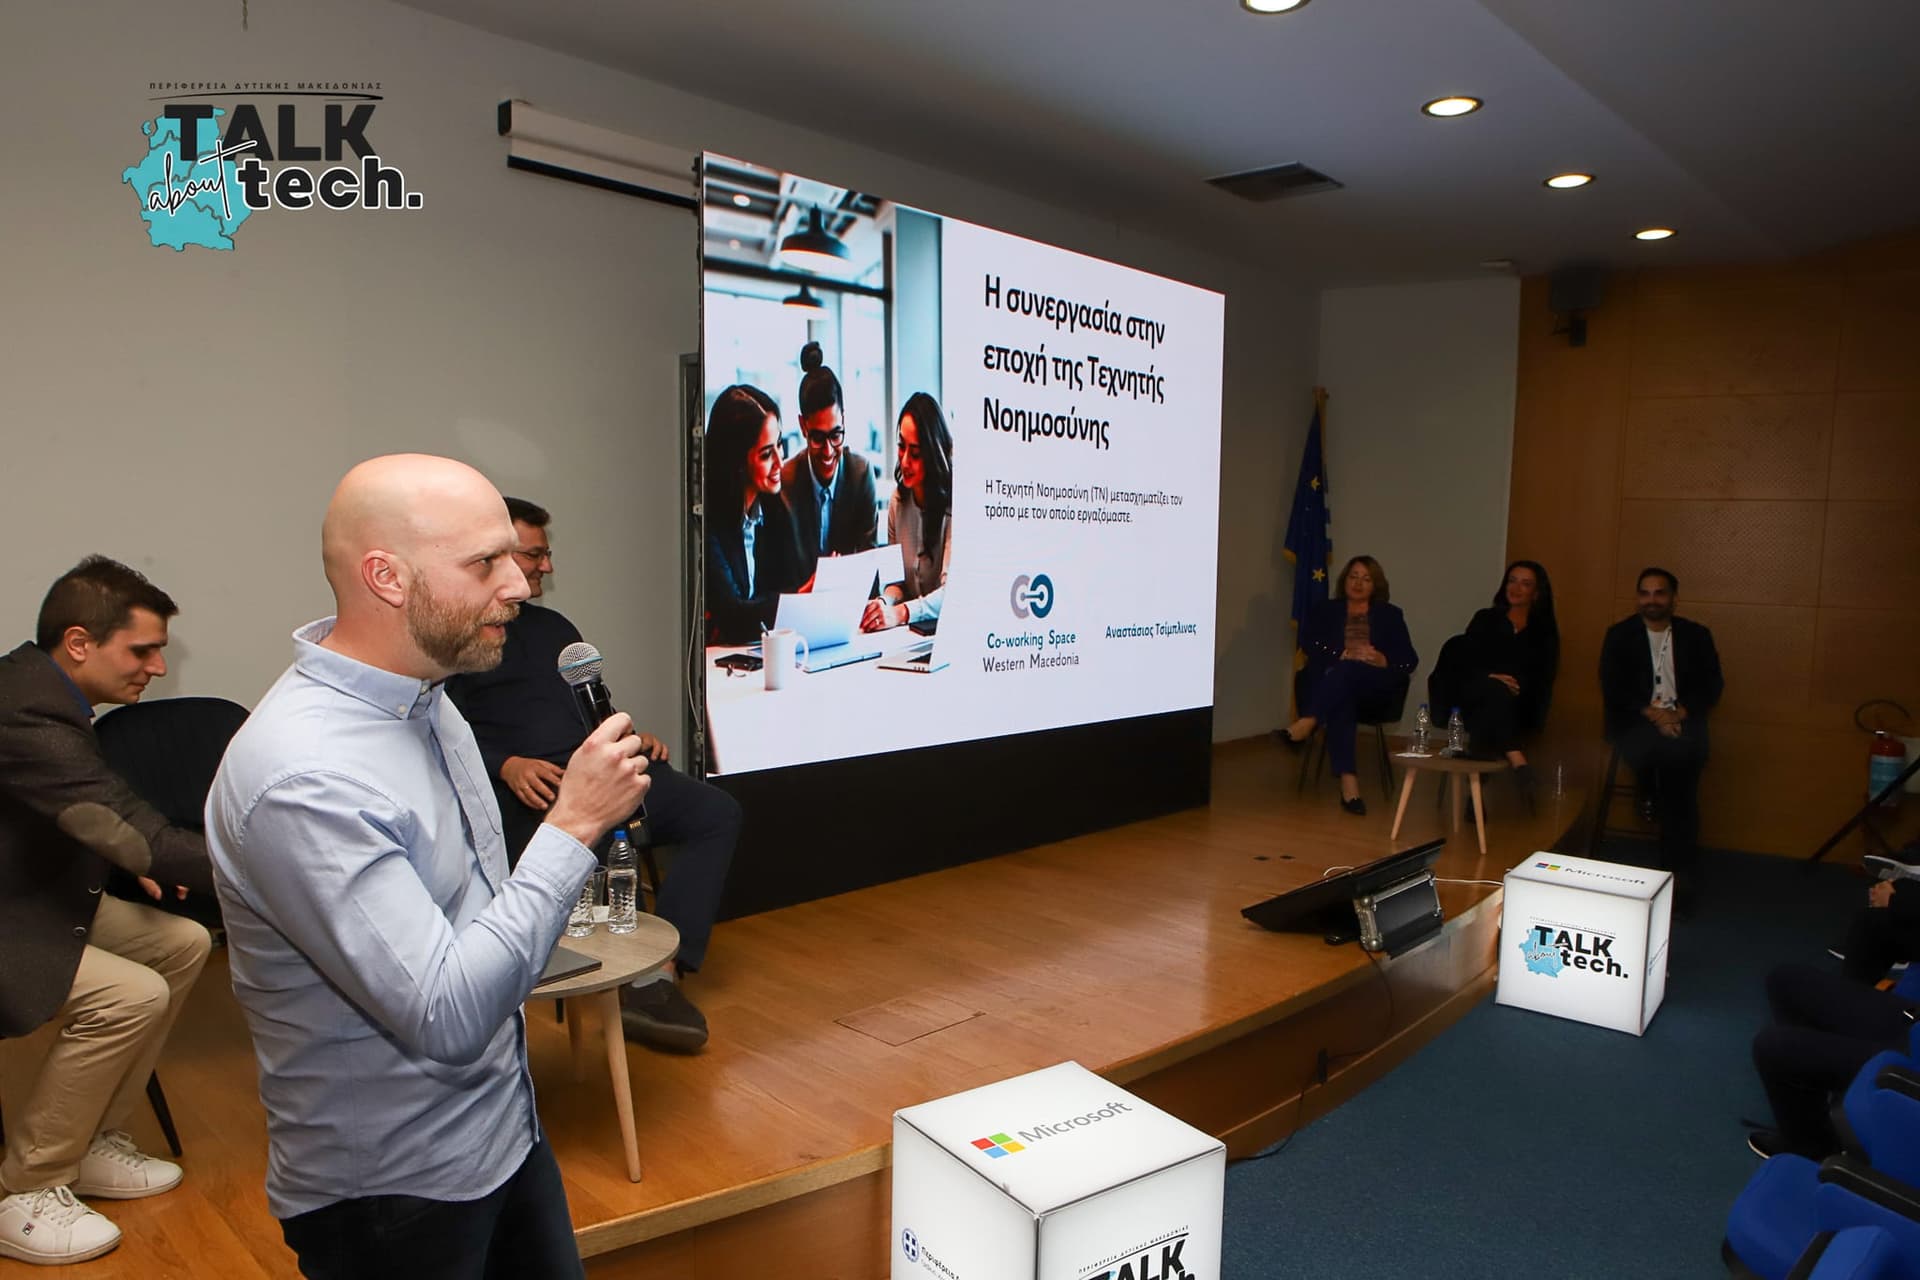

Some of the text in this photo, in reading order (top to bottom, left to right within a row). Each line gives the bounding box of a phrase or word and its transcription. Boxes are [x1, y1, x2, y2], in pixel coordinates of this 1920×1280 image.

[985, 273, 1165, 349] Η συνεργασία στην
[984, 343, 1165, 404] εποχή της Τεχνητής
[984, 397, 1110, 450] Νοημοσύνης
[995, 480, 1034, 499] Τεχνητή
[1036, 483, 1088, 502] Νοημοσύνη
[1110, 491, 1169, 507] μετασχηματίζει
[1170, 495, 1183, 506] τον
[985, 501, 1133, 524] τρόπο με τον οποίο εργαζόμαστε.
[987, 629, 1076, 650] Co-working Space
[1105, 621, 1197, 639] Αναστάσιος Τσίμπλινας
[983, 652, 1079, 673] Western Macedonia
[1565, 867, 1645, 885] Microsoft
[1534, 925, 1613, 958] TALK
[1560, 949, 1629, 979] tech.
[1017, 1102, 1133, 1142] Microsoft
